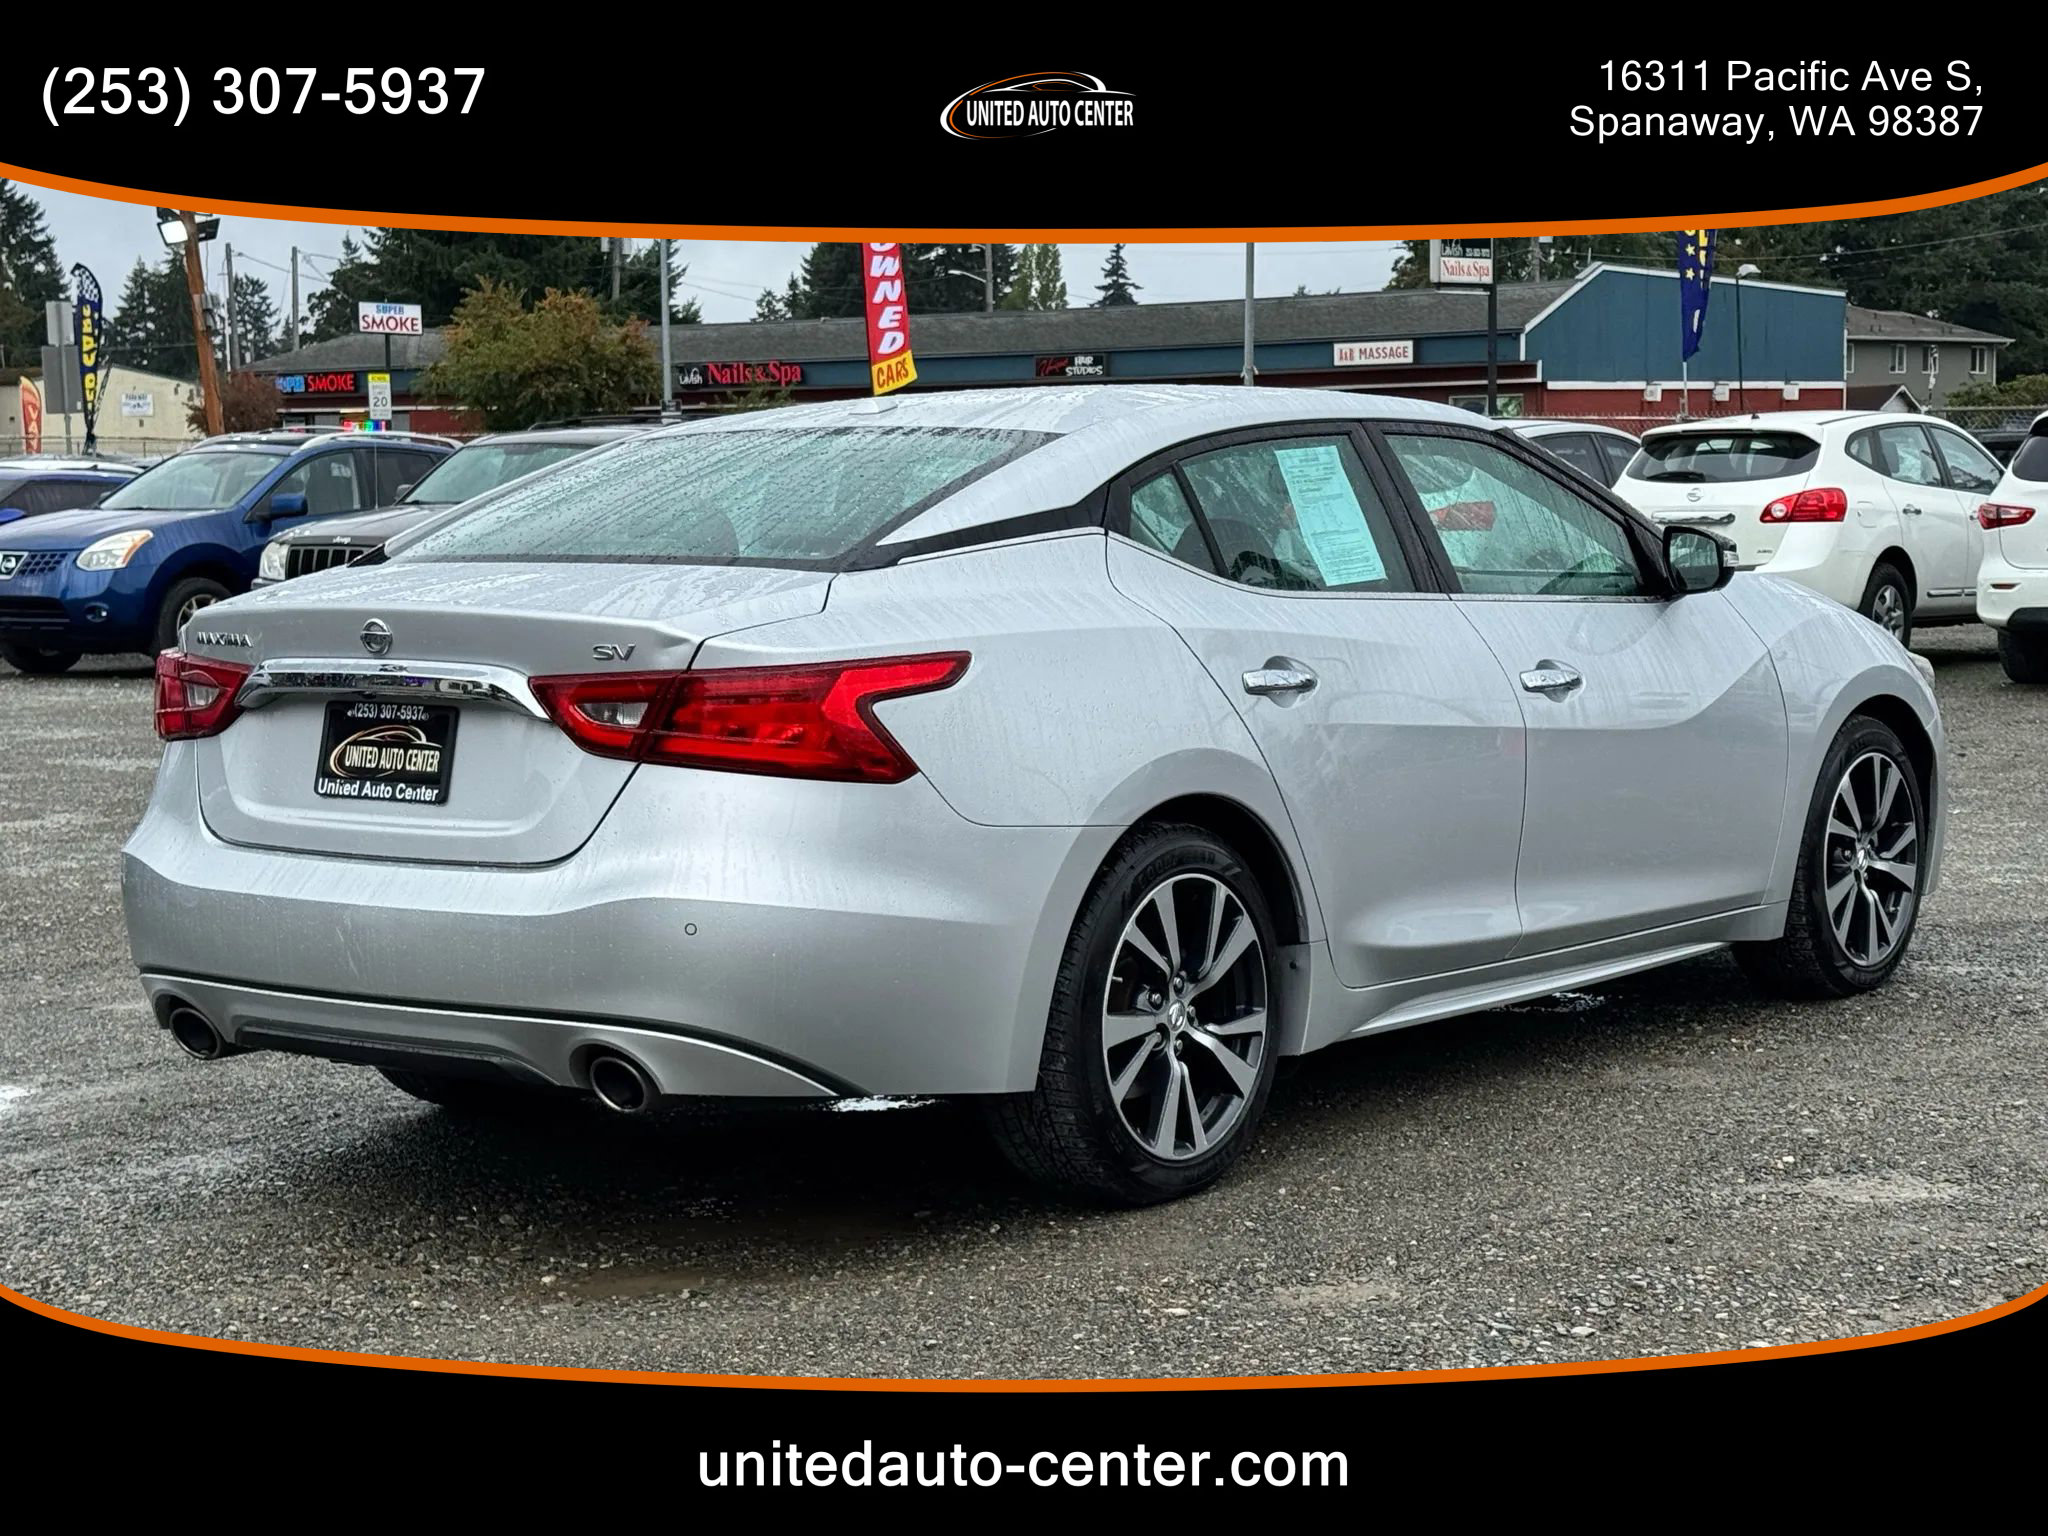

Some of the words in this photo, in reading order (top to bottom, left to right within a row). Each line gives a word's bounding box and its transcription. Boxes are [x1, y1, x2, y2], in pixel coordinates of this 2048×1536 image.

[361, 314, 420, 332] SMOKE
[1358, 345, 1409, 361] MASSAGE
[876, 357, 910, 389] CARS
[1065, 365, 1104, 377] STUDIOS
[307, 373, 354, 391] SMOKE
[373, 396, 388, 408] 20
[197, 631, 254, 648] MAXIMA
[592, 643, 636, 662] SV
[354, 703, 378, 719] (253)
[380, 704, 424, 720] 307-5937
[344, 745, 379, 769] UNITED
[379, 748, 404, 771] AUTO
[405, 749, 440, 773] CENTER
[318, 778, 360, 796] United
[361, 781, 392, 799] Auto
[395, 783, 439, 802] Center
